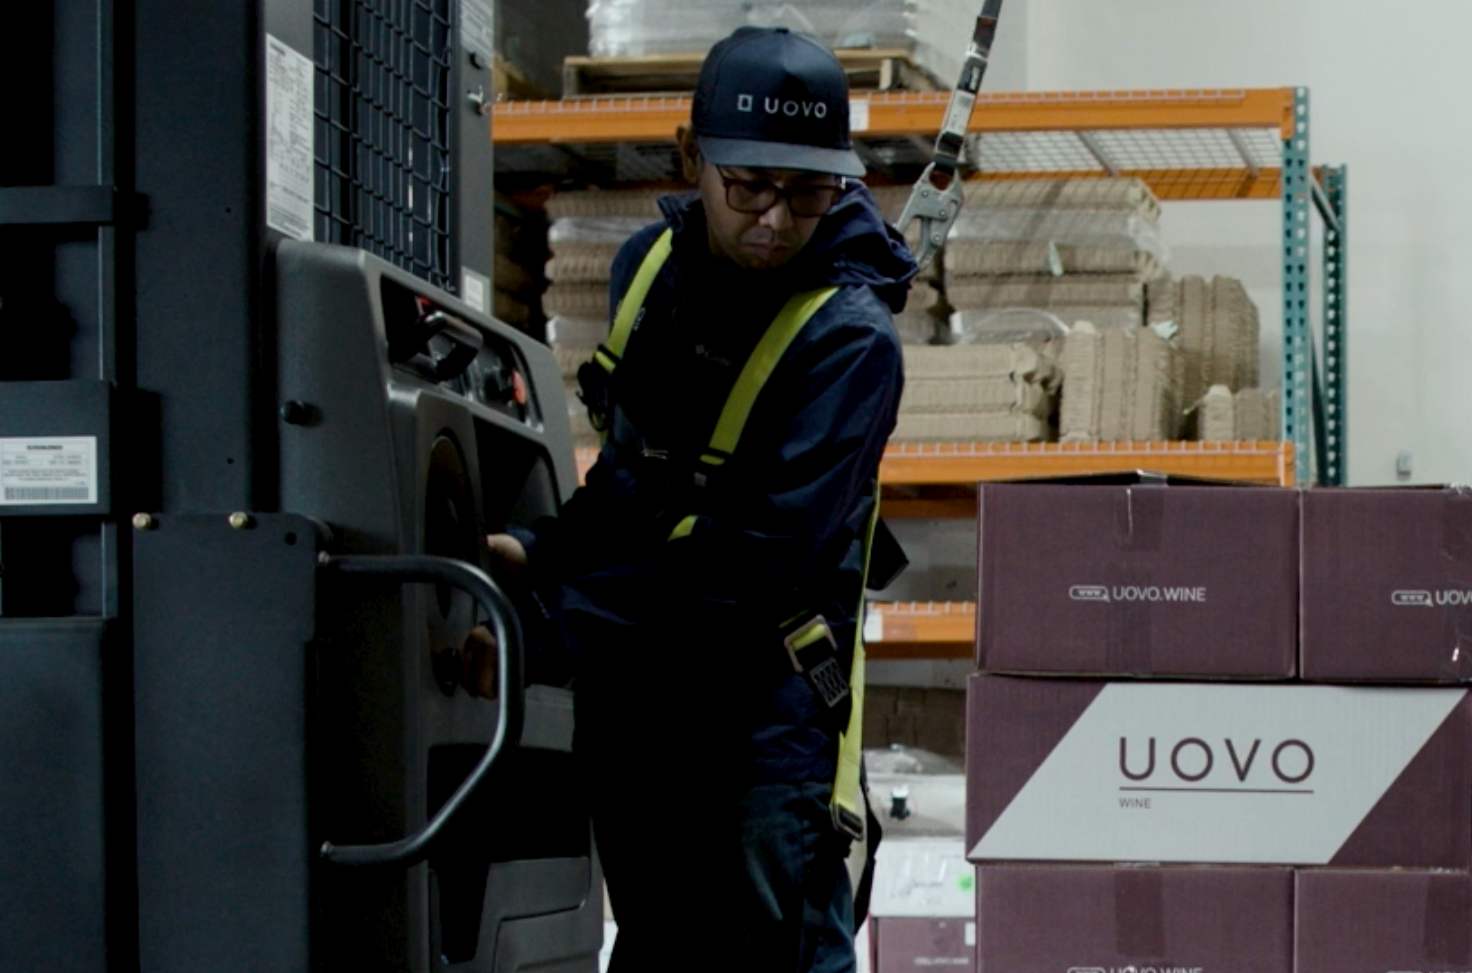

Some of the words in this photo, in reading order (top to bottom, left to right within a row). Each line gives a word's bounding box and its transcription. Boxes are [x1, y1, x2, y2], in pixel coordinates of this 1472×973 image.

[764, 96, 828, 119] UOVO
[1112, 585, 1208, 602] UOVO.WINE
[1118, 736, 1316, 785] UOVO
[1118, 797, 1152, 809] WINE
